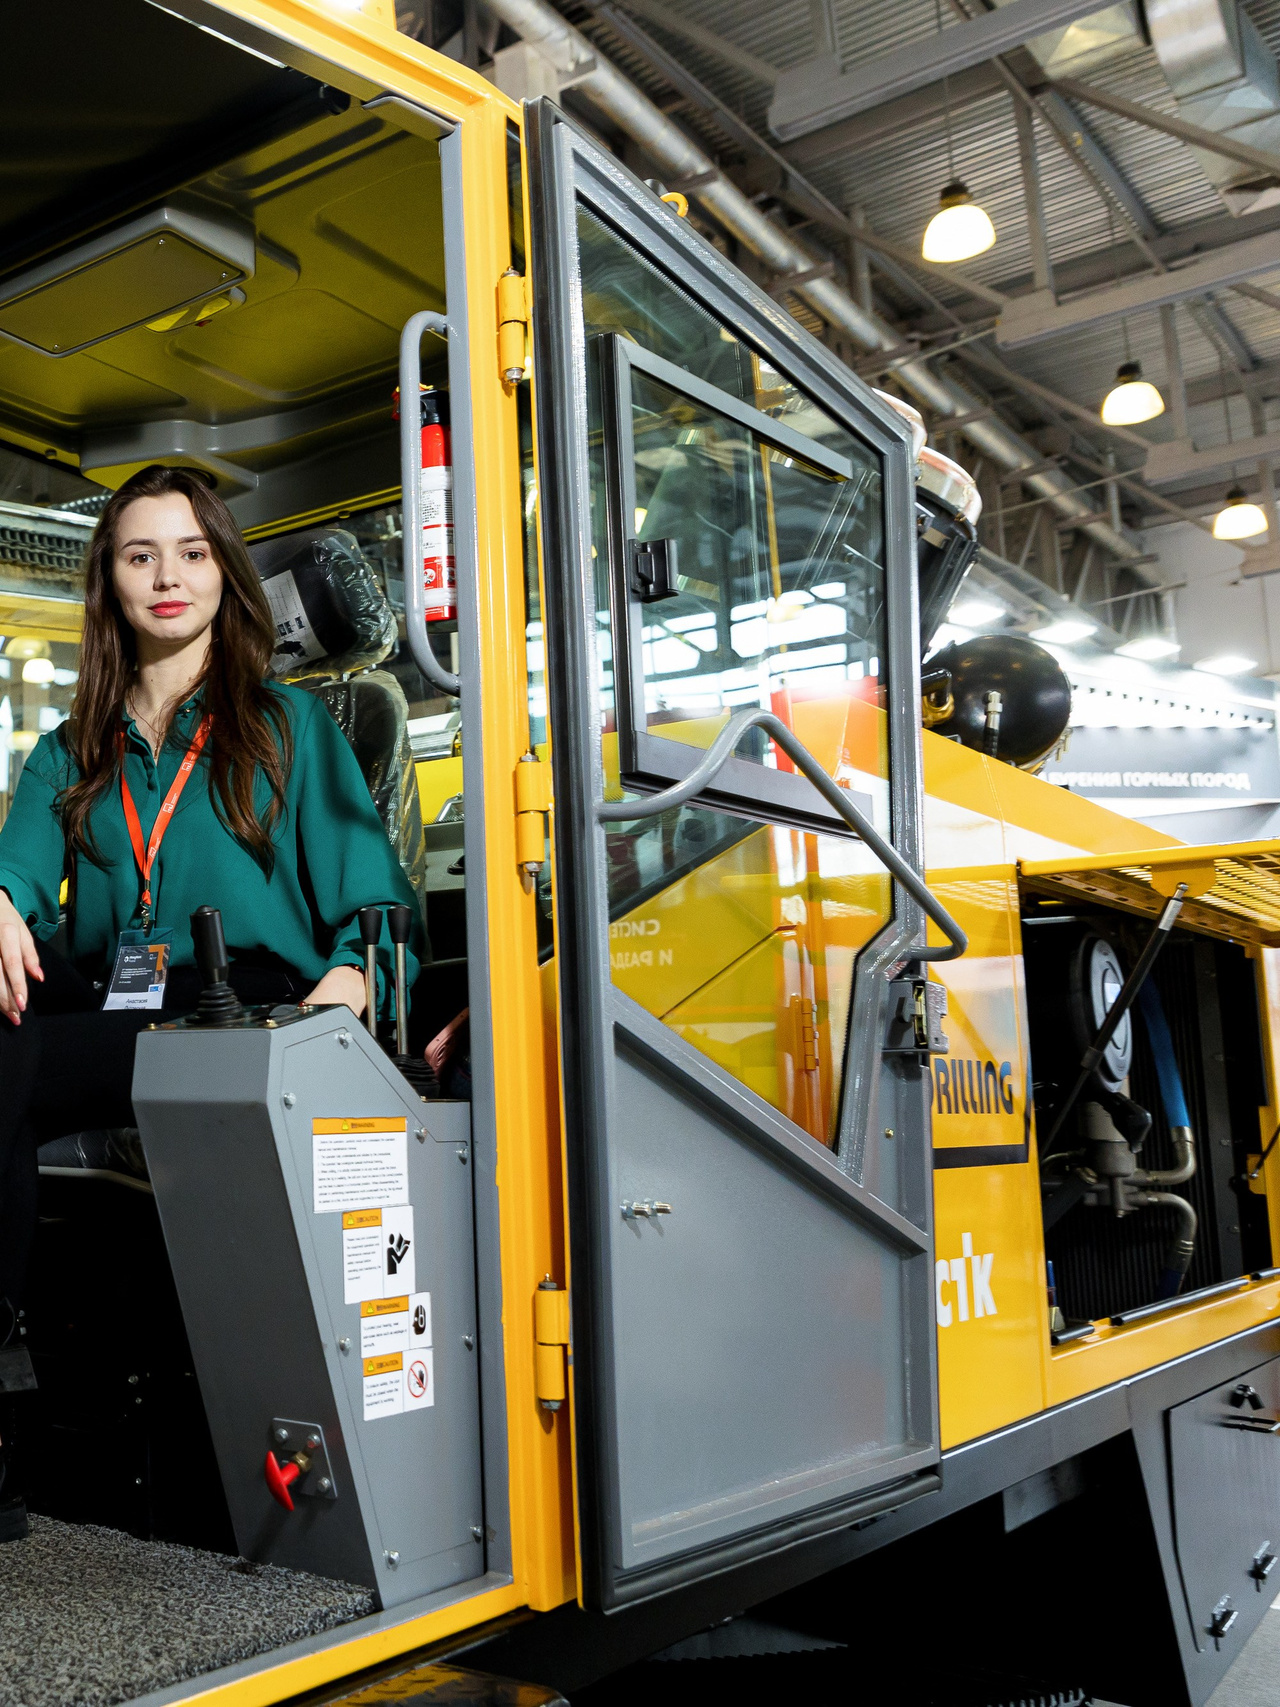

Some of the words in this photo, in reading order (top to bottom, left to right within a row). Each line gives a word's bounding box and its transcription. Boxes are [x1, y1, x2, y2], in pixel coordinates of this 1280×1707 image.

[1122, 771, 1190, 788] ГОРНЫХ
[1191, 772, 1251, 790] ПОРОД
[929, 1057, 1014, 1115] RILLING
